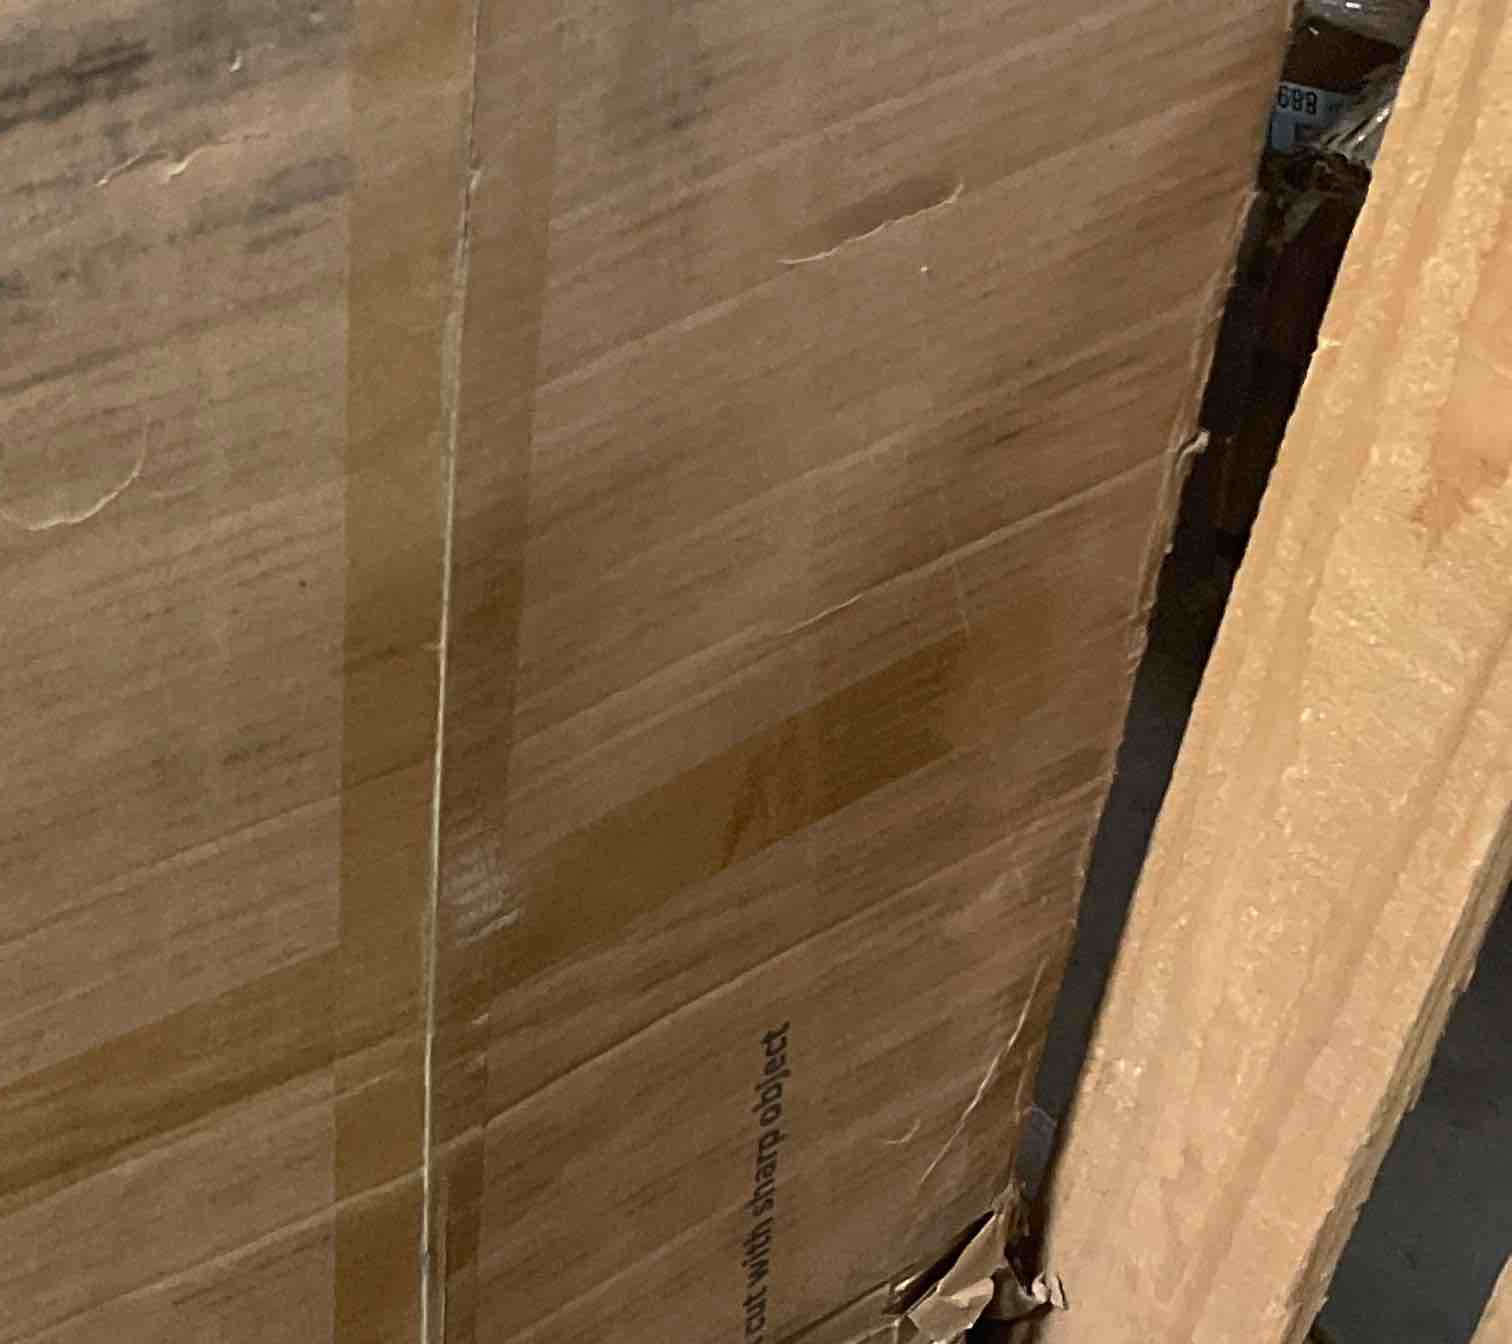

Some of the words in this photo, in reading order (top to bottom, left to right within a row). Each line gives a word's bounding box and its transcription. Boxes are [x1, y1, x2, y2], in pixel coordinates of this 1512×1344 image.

[751, 1021, 791, 1127] object
[744, 1130, 787, 1216] sharp
[741, 1217, 774, 1289] with
[743, 1284, 768, 1337] cut
